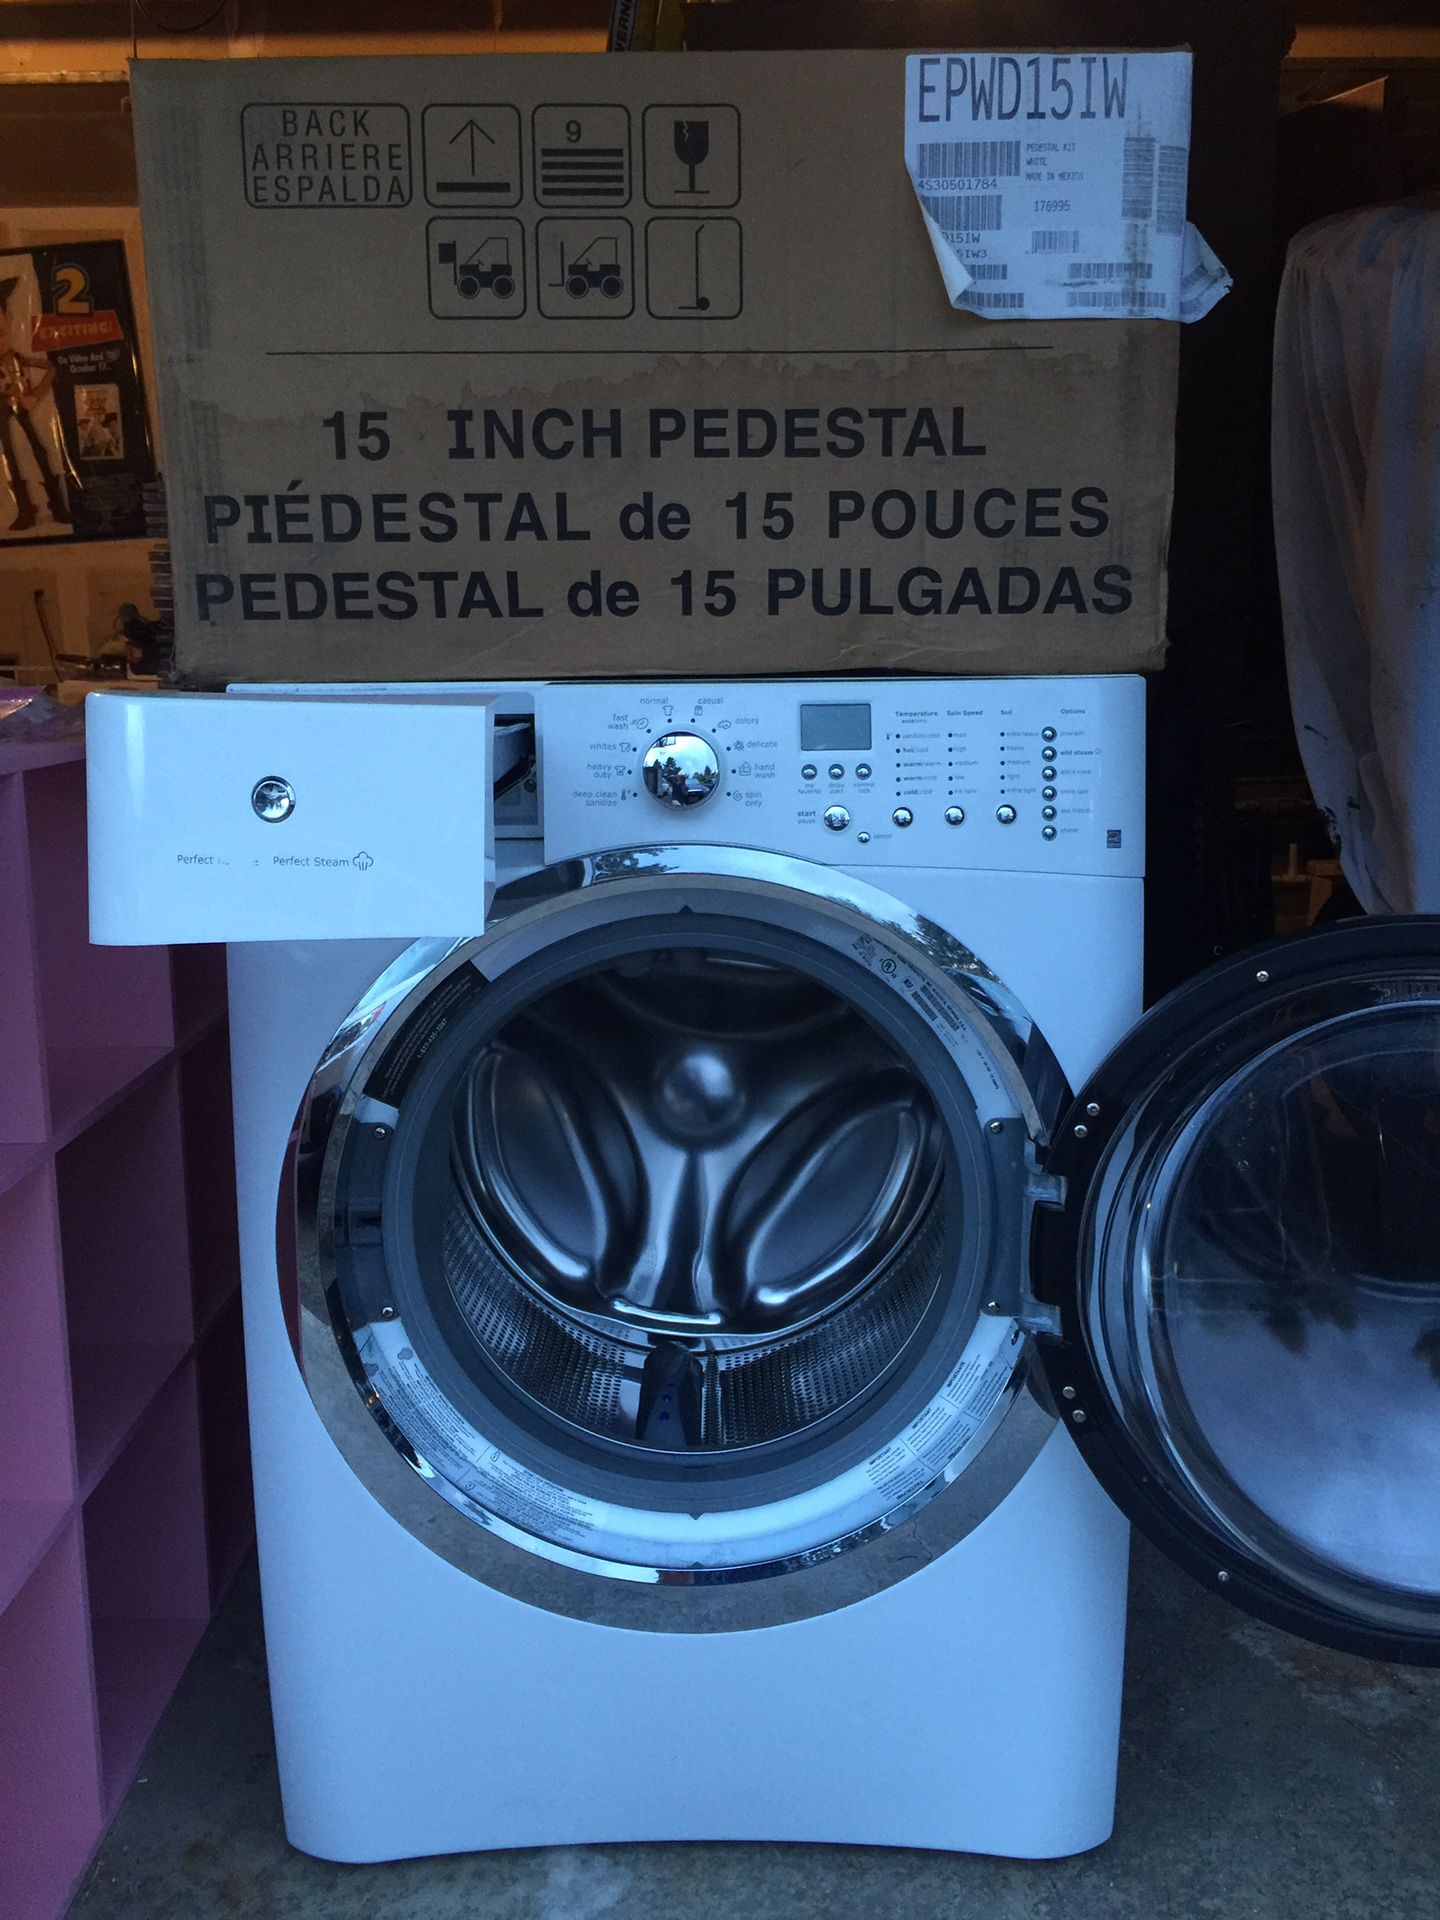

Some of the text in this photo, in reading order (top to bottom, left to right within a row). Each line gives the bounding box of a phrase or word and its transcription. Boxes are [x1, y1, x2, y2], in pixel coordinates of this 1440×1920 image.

[918, 56, 1128, 123] EPWD15IW
[282, 109, 370, 137] BACK
[566, 120, 581, 143] 9
[252, 143, 403, 171] ARRIERE
[253, 175, 405, 203] ESPALDA
[917, 178, 998, 191] 4S30501784
[54, 265, 91, 316] 2
[323, 407, 987, 461] 15 INCH PEDESTAL
[203, 480, 591, 544] PIÉDESTAL
[619, 491, 691, 540] de
[725, 491, 795, 540] 15
[828, 487, 1110, 539] POUCES
[195, 566, 1133, 622] PEDESTAL de 15 PULGADAS
[640, 697, 669, 705] normal
[698, 696, 723, 705] casual
[177, 855, 214, 865] Perfect
[273, 856, 350, 867] Perfect Steam
